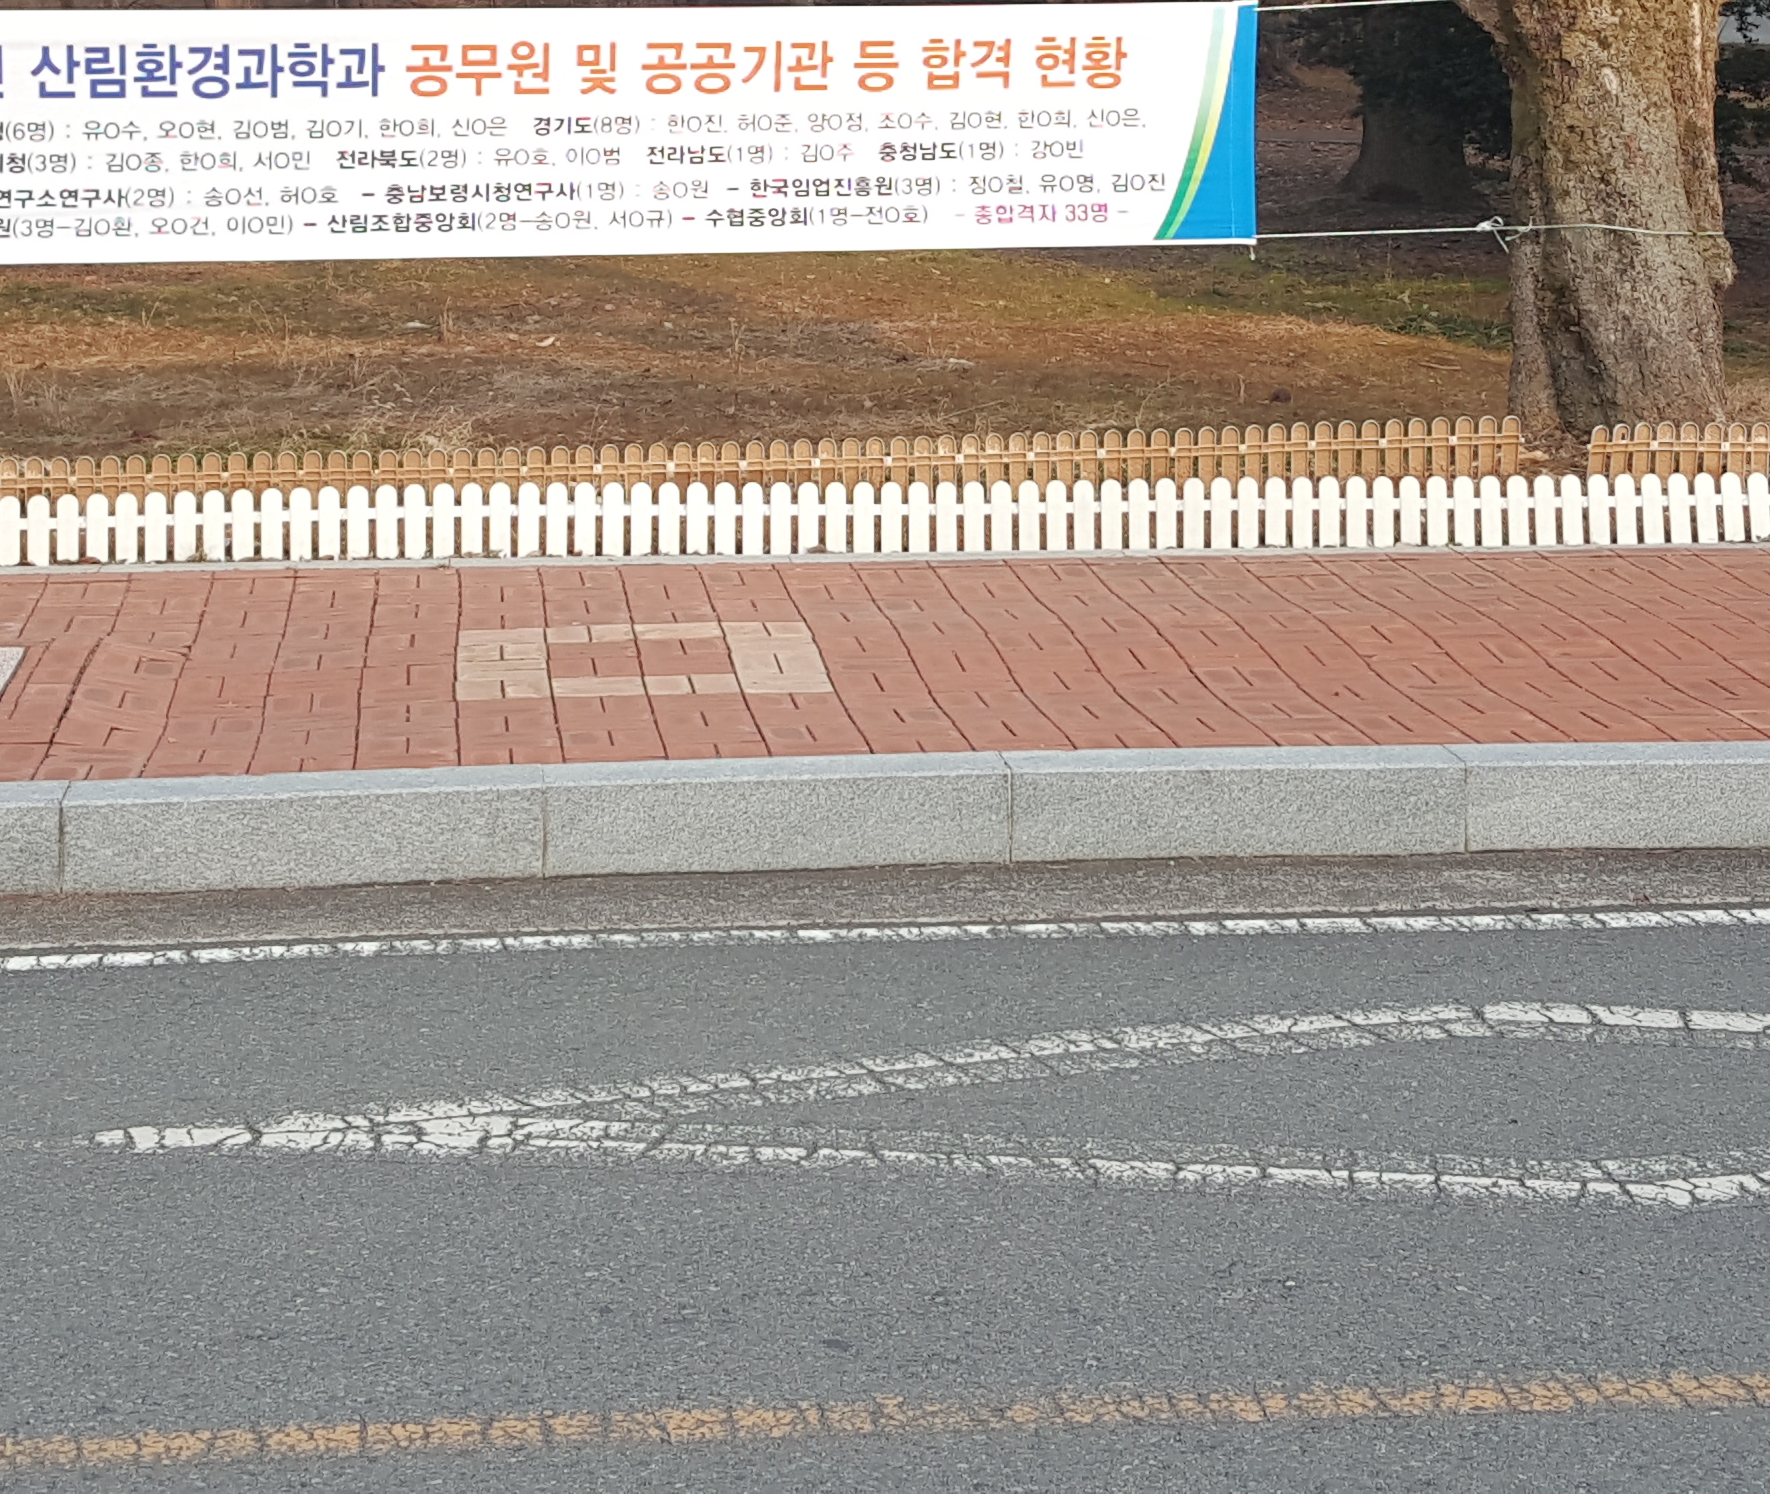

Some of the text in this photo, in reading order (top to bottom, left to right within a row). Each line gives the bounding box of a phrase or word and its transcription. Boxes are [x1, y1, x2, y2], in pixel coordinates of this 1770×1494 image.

[30, 42, 386, 100] 산림환경과학과
[405, 40, 551, 98] 공무원
[576, 41, 618, 96] 및
[640, 39, 835, 96] 공공기관
[852, 40, 900, 93] 등
[921, 37, 1012, 91] 합격
[1034, 35, 1129, 90] 현황
[1064, 202, 1109, 224] 33명
